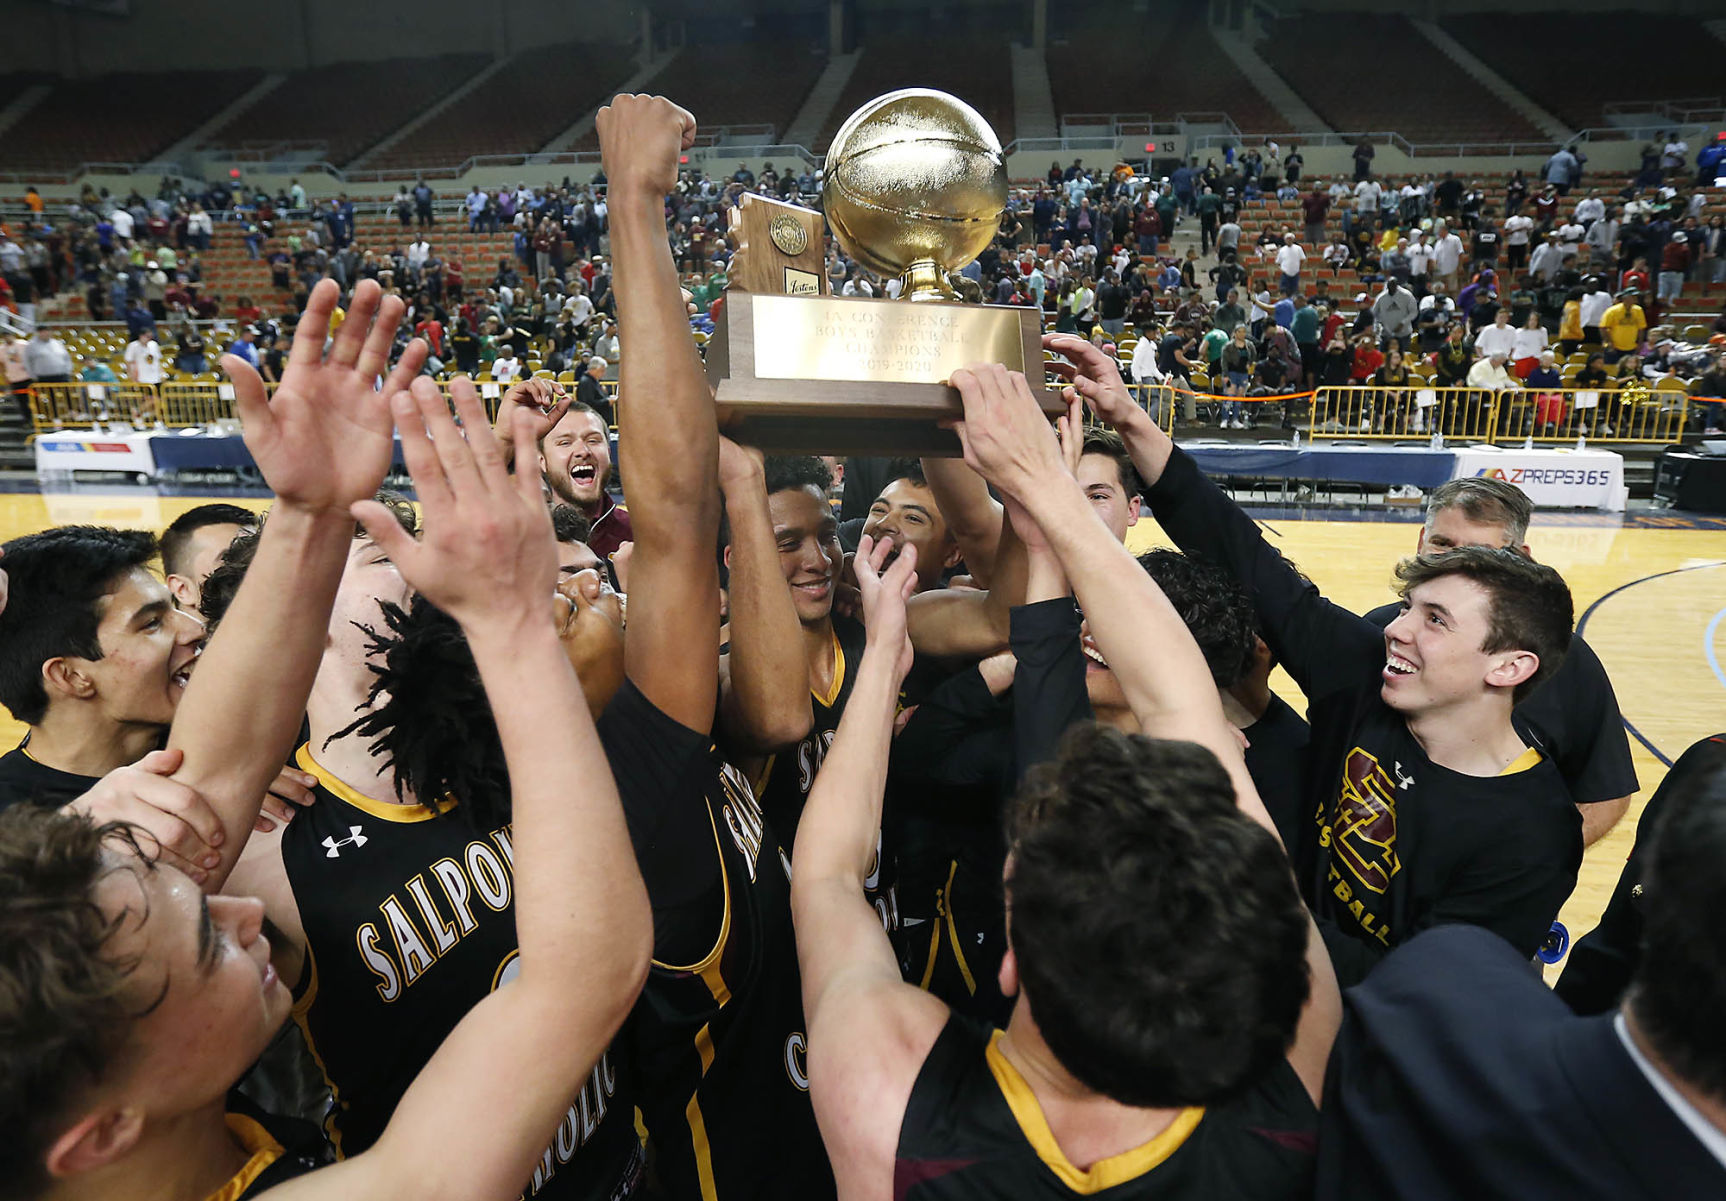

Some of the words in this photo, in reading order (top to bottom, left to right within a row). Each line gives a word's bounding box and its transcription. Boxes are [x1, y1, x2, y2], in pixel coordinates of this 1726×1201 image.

[1162, 142, 1175, 152] 13
[848, 311, 959, 328] CONERENCE
[857, 358, 931, 373] 2019-2020
[1492, 468, 1610, 486] AZPREPS365
